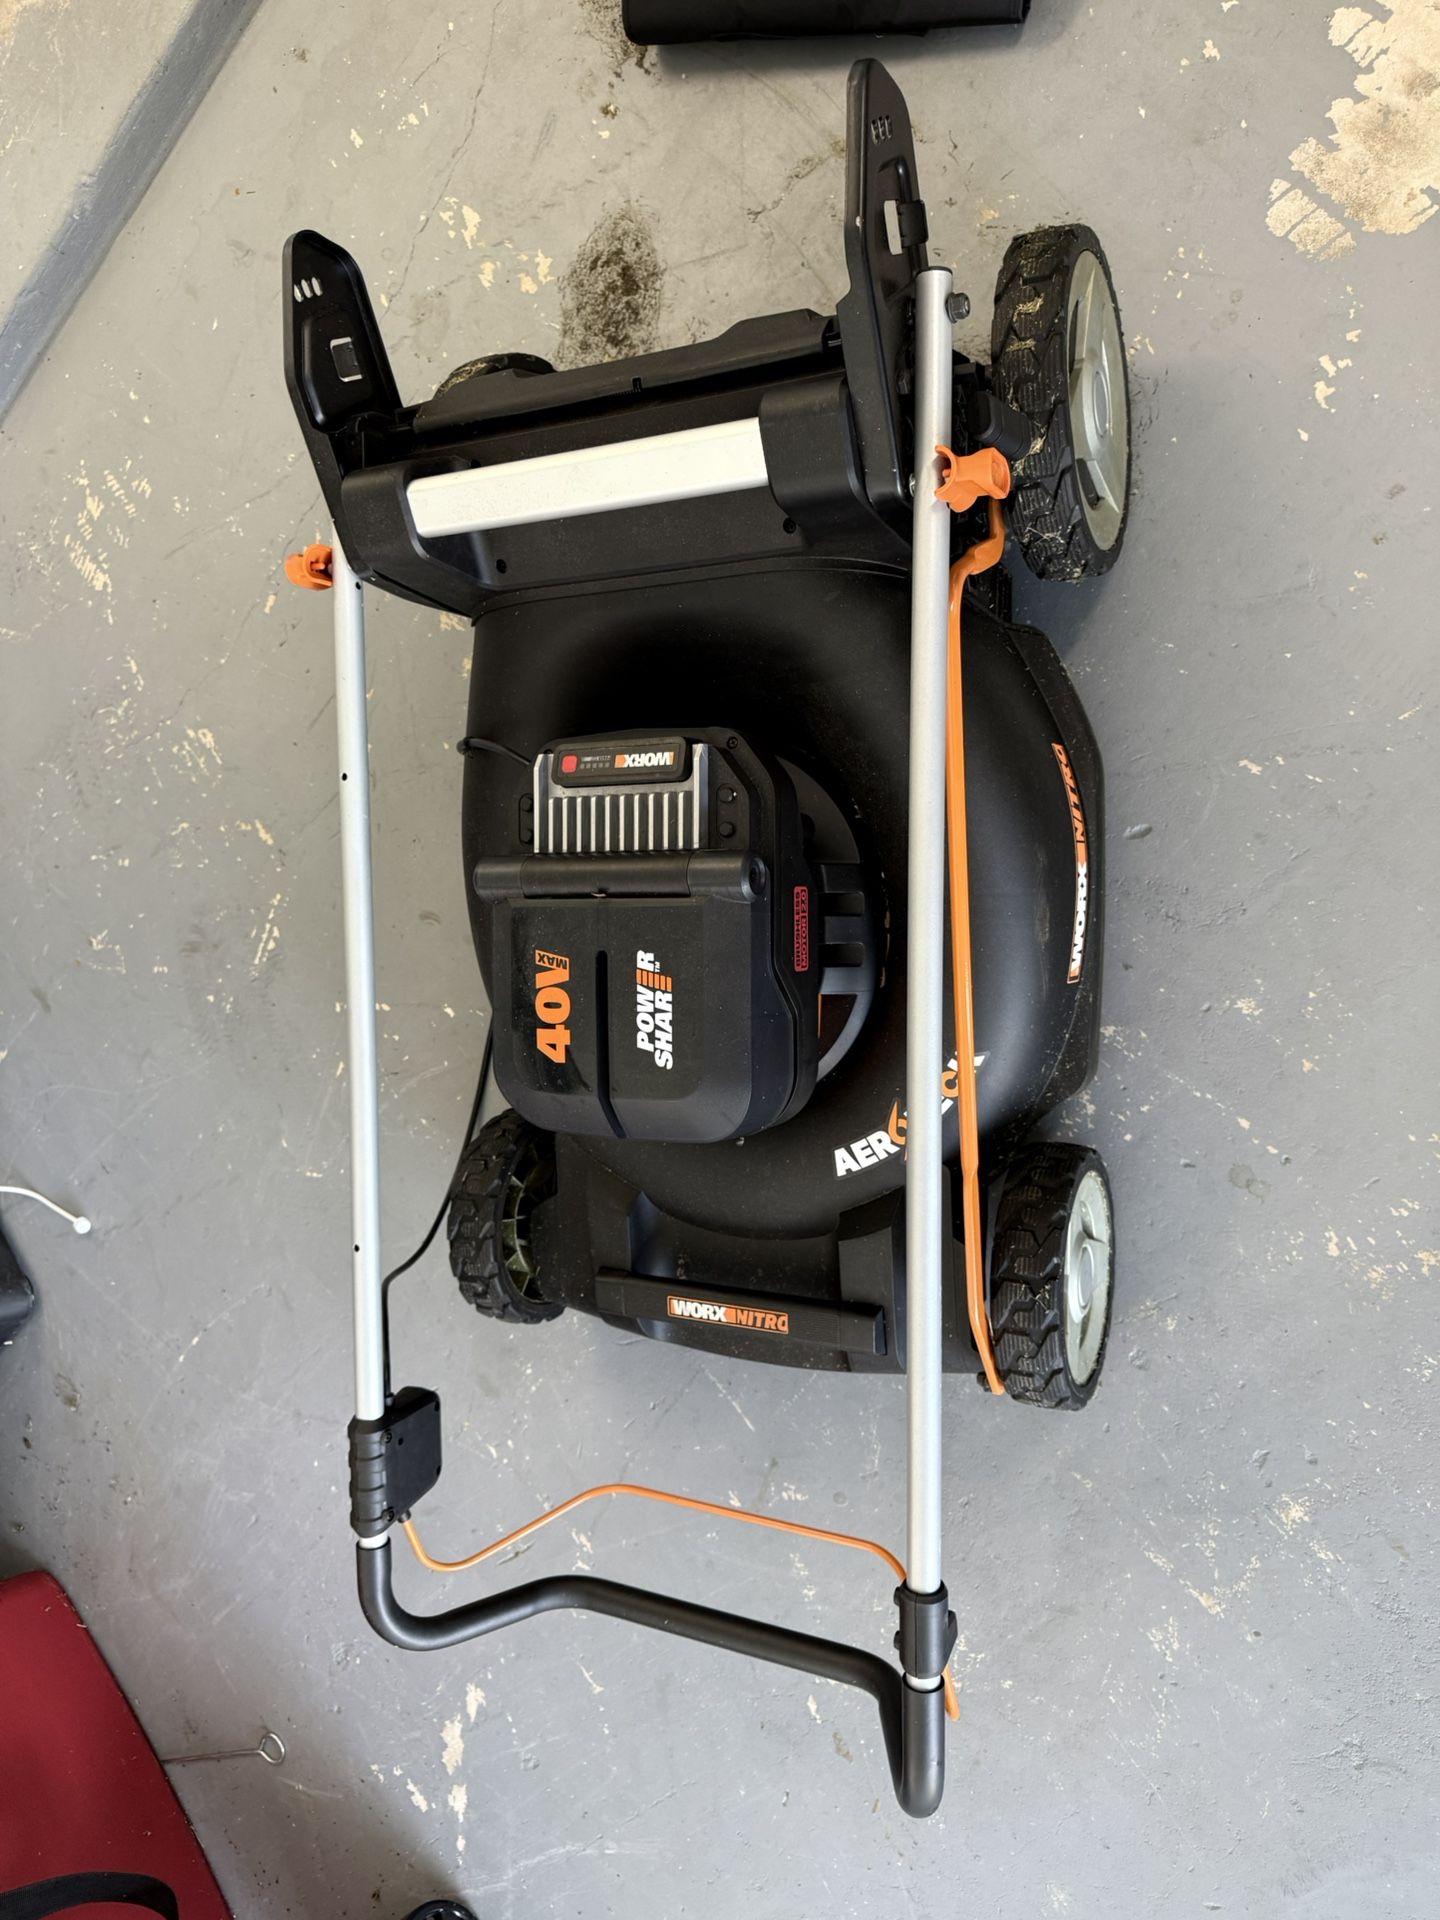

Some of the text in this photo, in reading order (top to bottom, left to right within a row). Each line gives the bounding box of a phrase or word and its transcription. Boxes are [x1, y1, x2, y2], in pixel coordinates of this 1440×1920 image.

[623, 752, 672, 767] WORX
[1053, 744, 1088, 971] WORX NITRO
[535, 950, 570, 1064] 40V MAX
[636, 950, 655, 1053] POWER
[654, 970, 673, 1070] SHARE
[673, 1299, 788, 1332] WORX NITRO
